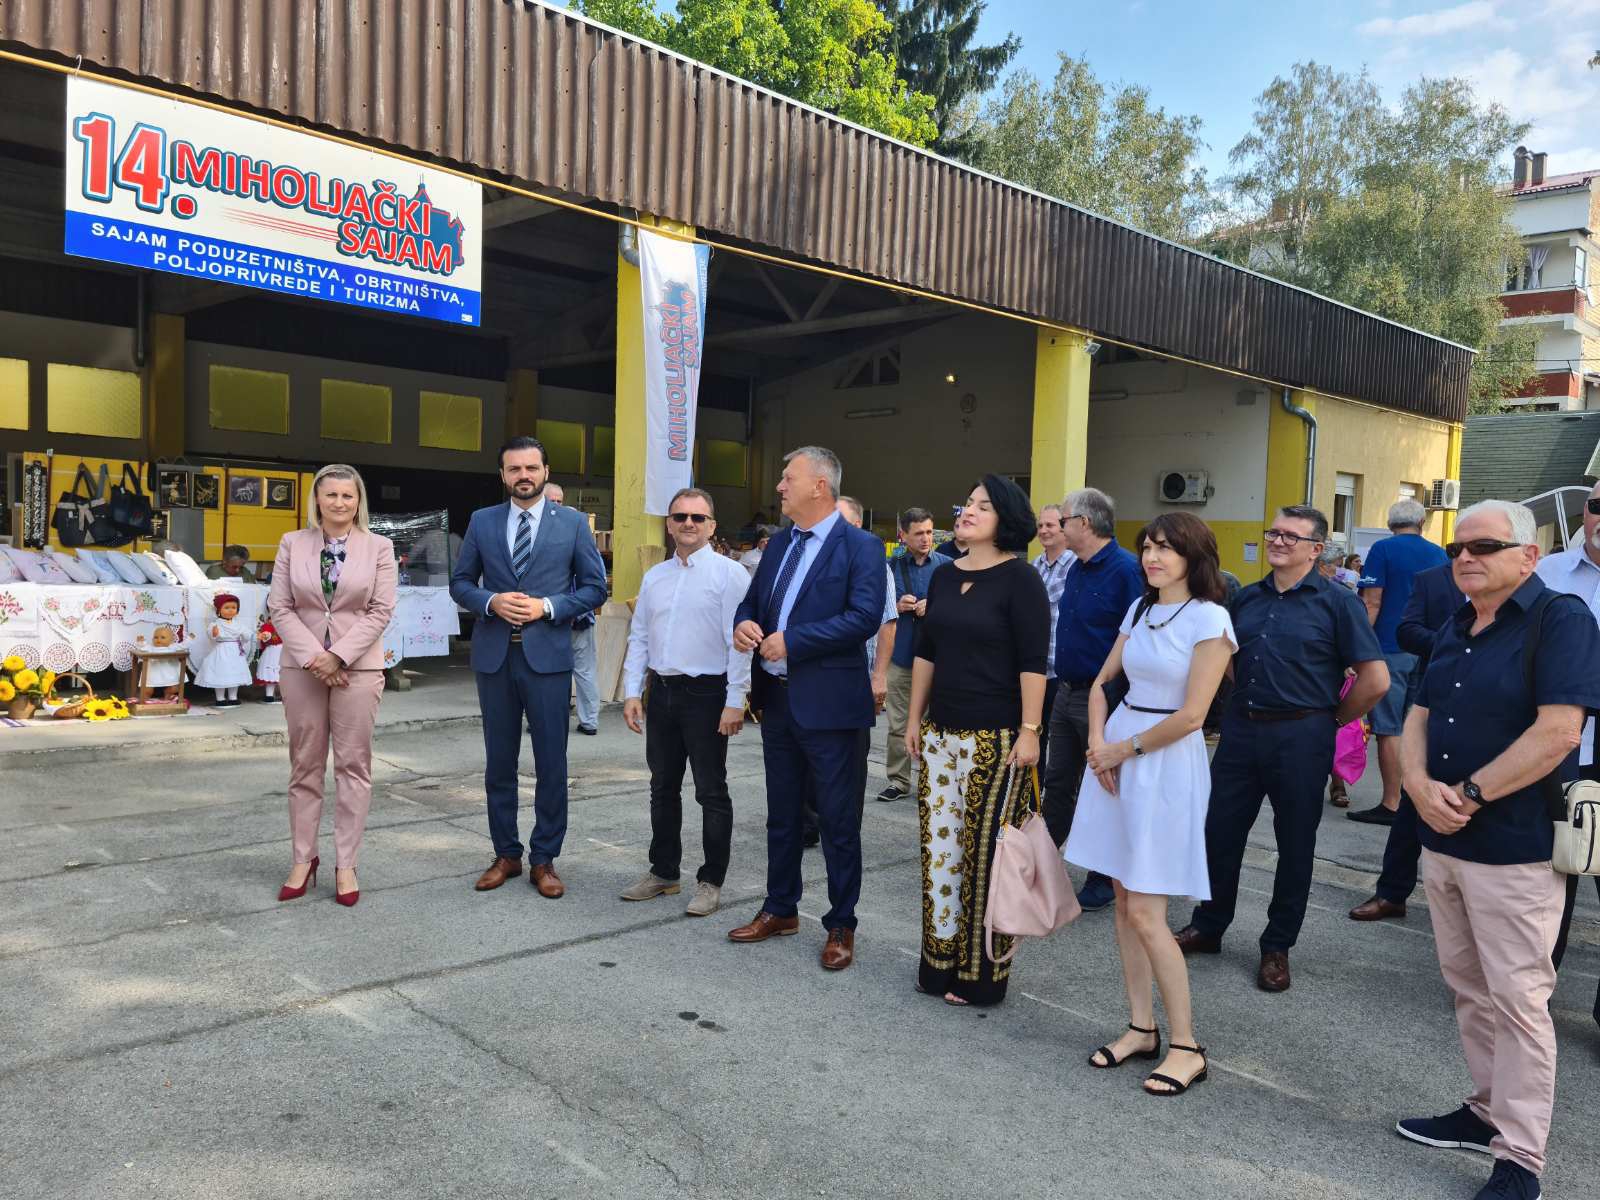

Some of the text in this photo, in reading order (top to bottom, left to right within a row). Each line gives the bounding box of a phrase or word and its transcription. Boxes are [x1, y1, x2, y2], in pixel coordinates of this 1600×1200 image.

[74, 112, 197, 219] 14.
[171, 141, 432, 238] MIHOLJAČKI
[91, 222, 466, 307] SAJAM PODUZETNIŠTVA, OBRTNIŠTVA,
[153, 251, 421, 312] POLJOPRIVREDE I TURIZMA
[337, 220, 454, 275] SAJAM
[683, 291, 699, 369] SAJAM
[660, 303, 687, 462] MIHOLJAČKI
